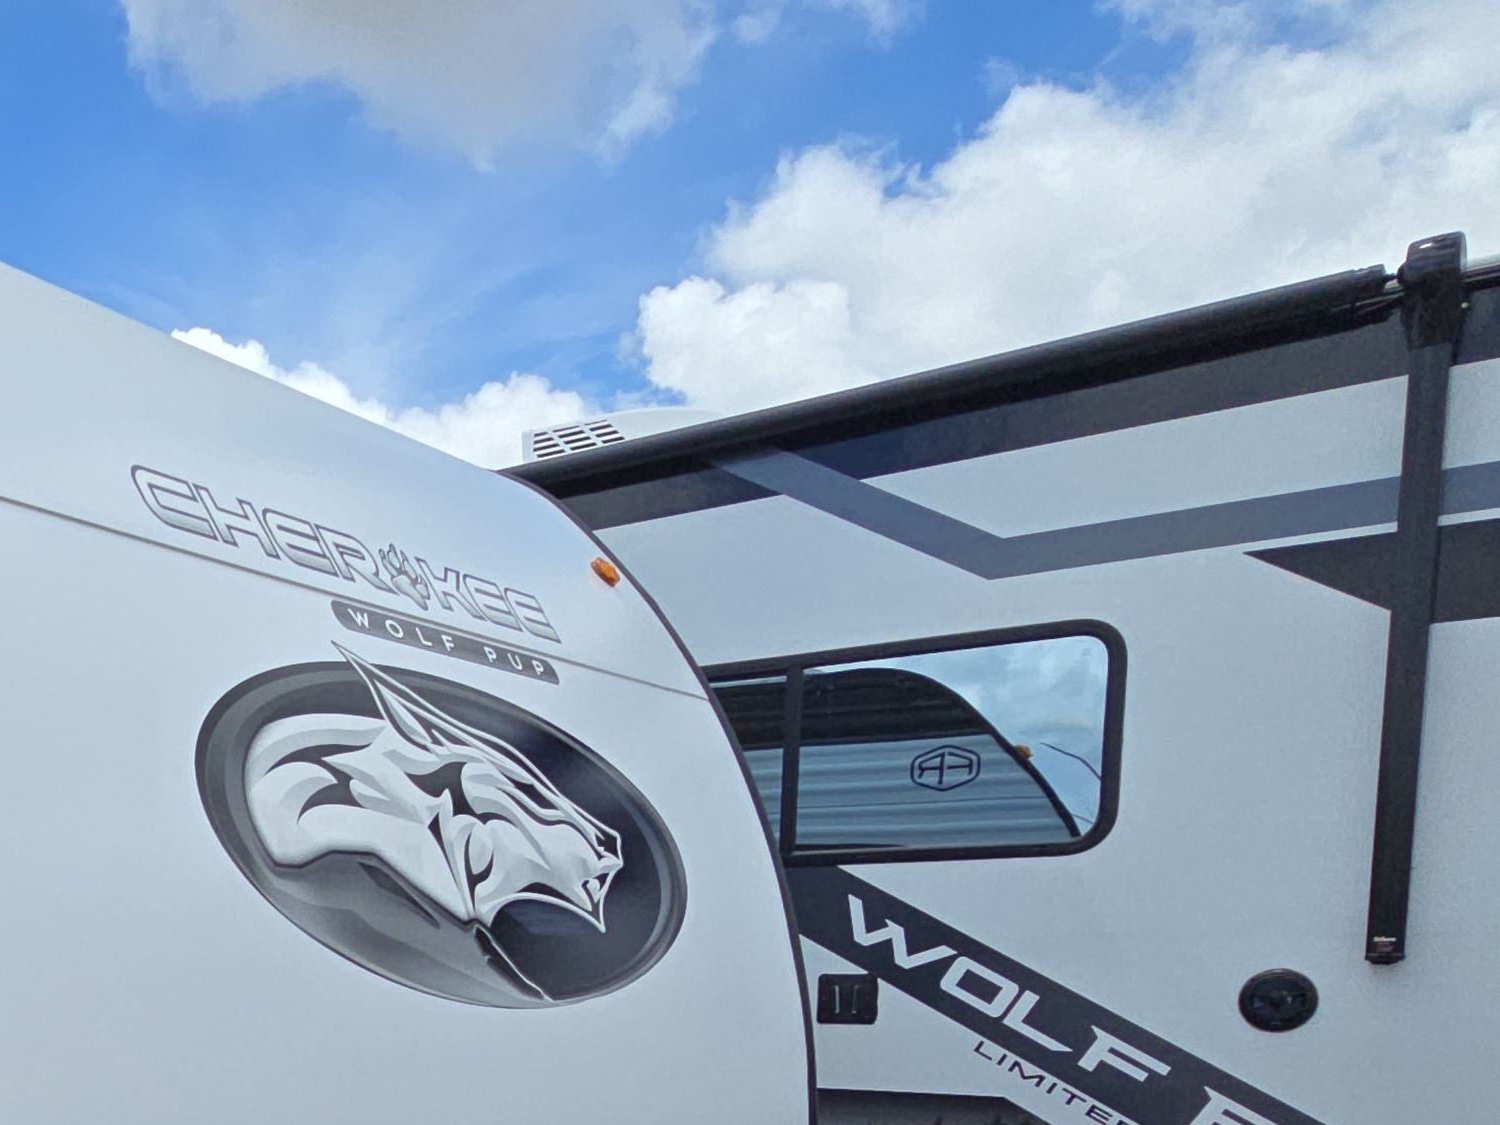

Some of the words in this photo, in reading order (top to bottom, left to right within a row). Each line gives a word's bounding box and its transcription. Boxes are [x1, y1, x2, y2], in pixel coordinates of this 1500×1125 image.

[348, 607, 457, 653] WOLF
[484, 645, 547, 677] PUP
[848, 893, 1172, 1082] WOLF
